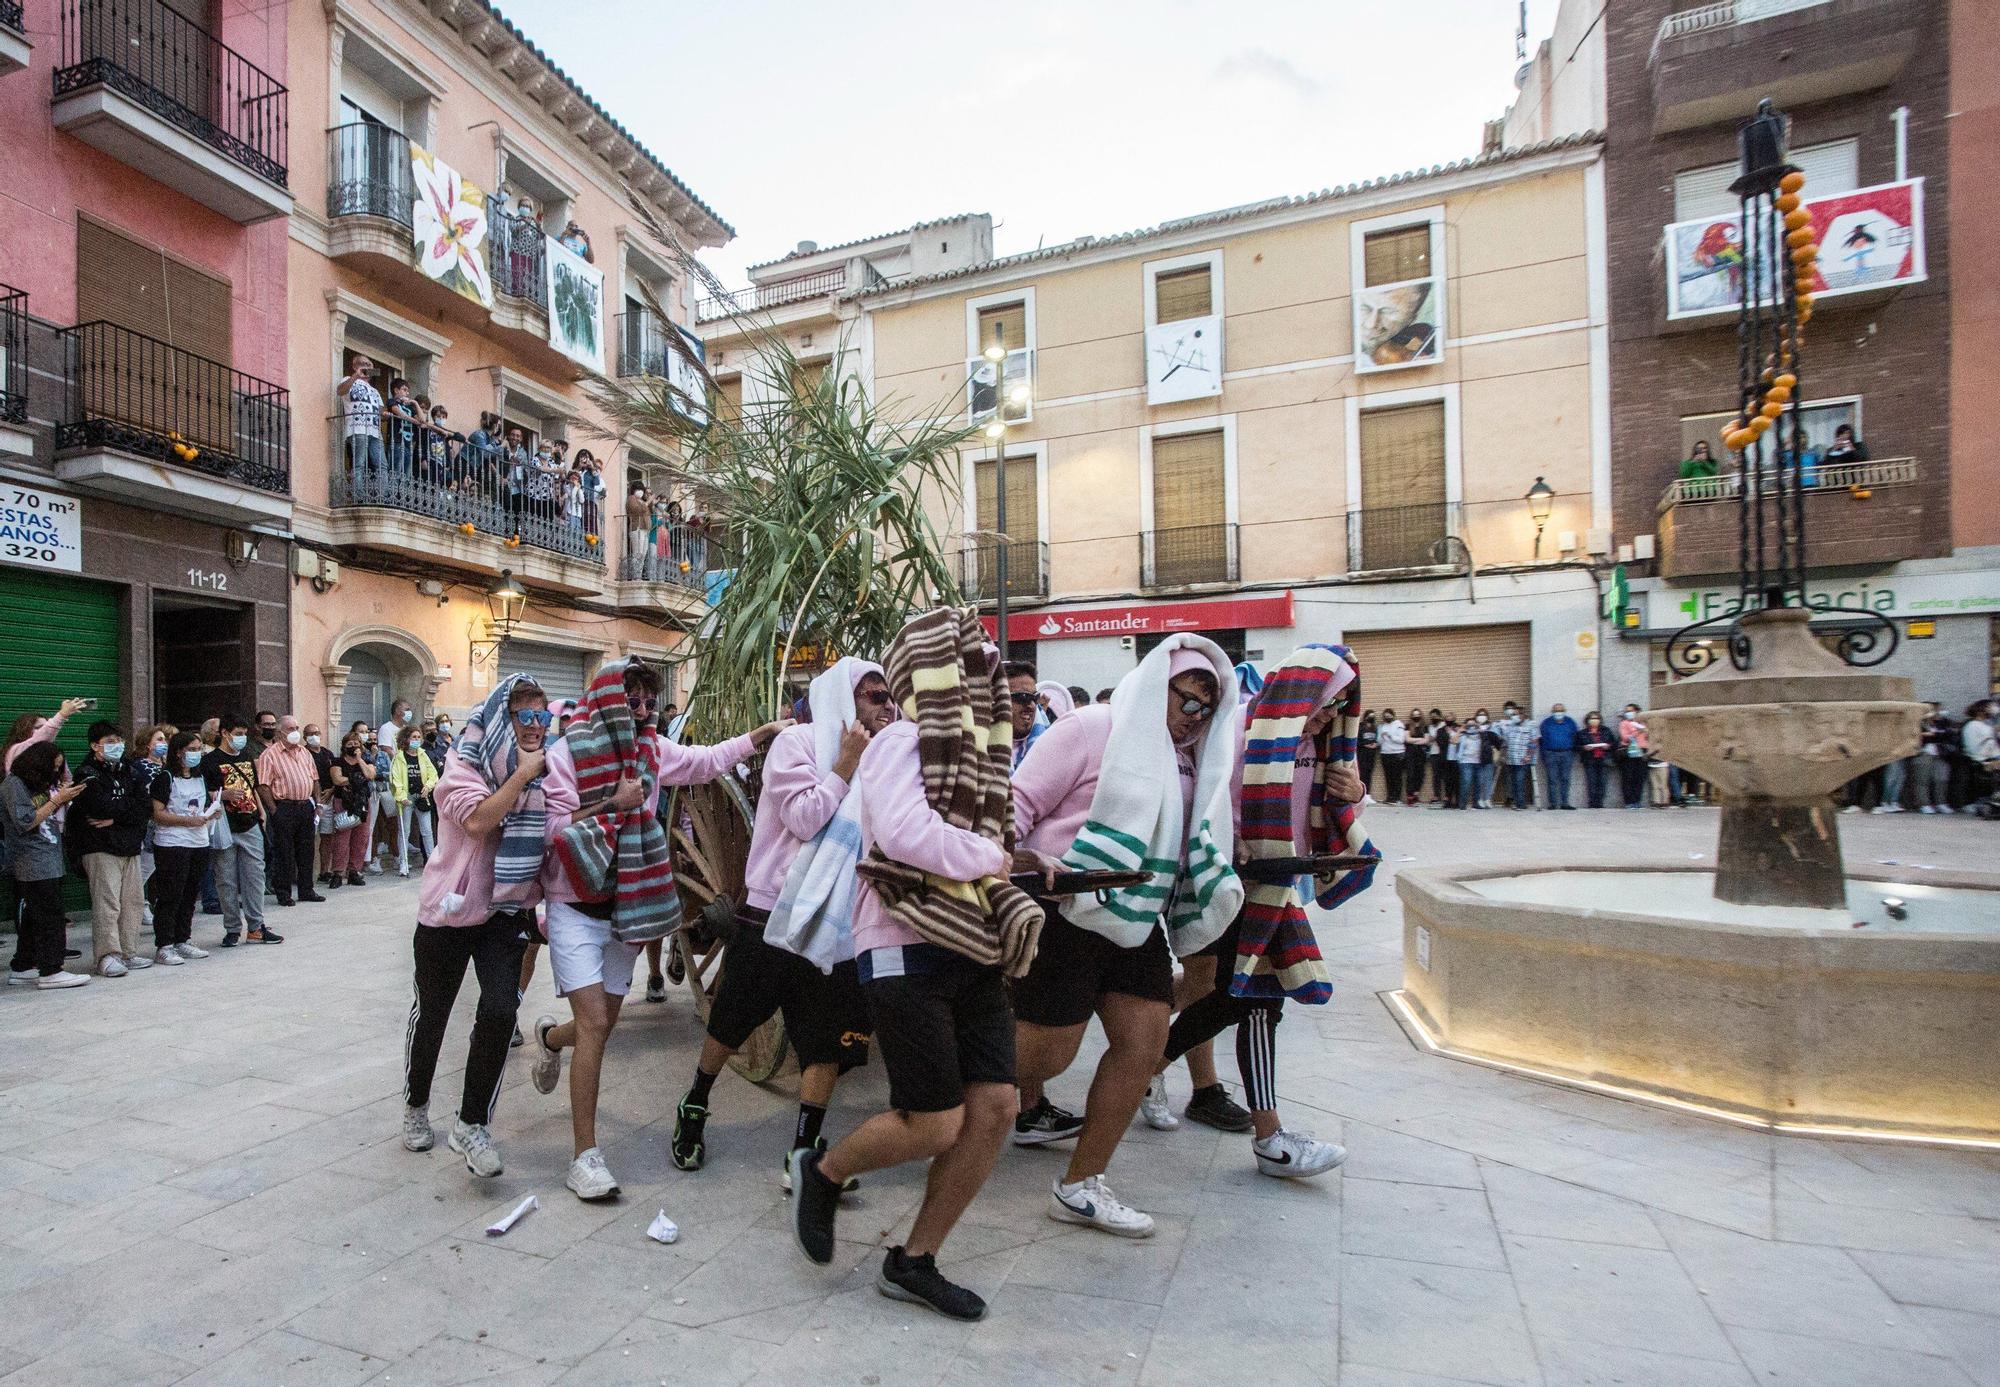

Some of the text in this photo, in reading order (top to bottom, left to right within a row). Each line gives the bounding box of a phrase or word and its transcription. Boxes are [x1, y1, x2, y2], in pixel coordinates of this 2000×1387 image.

[13, 491, 40, 508] 70
[5, 543, 56, 561] 320
[187, 568, 227, 590] 11-12
[1703, 583, 1895, 620] Faracia
[1064, 612, 1150, 633] Santander
